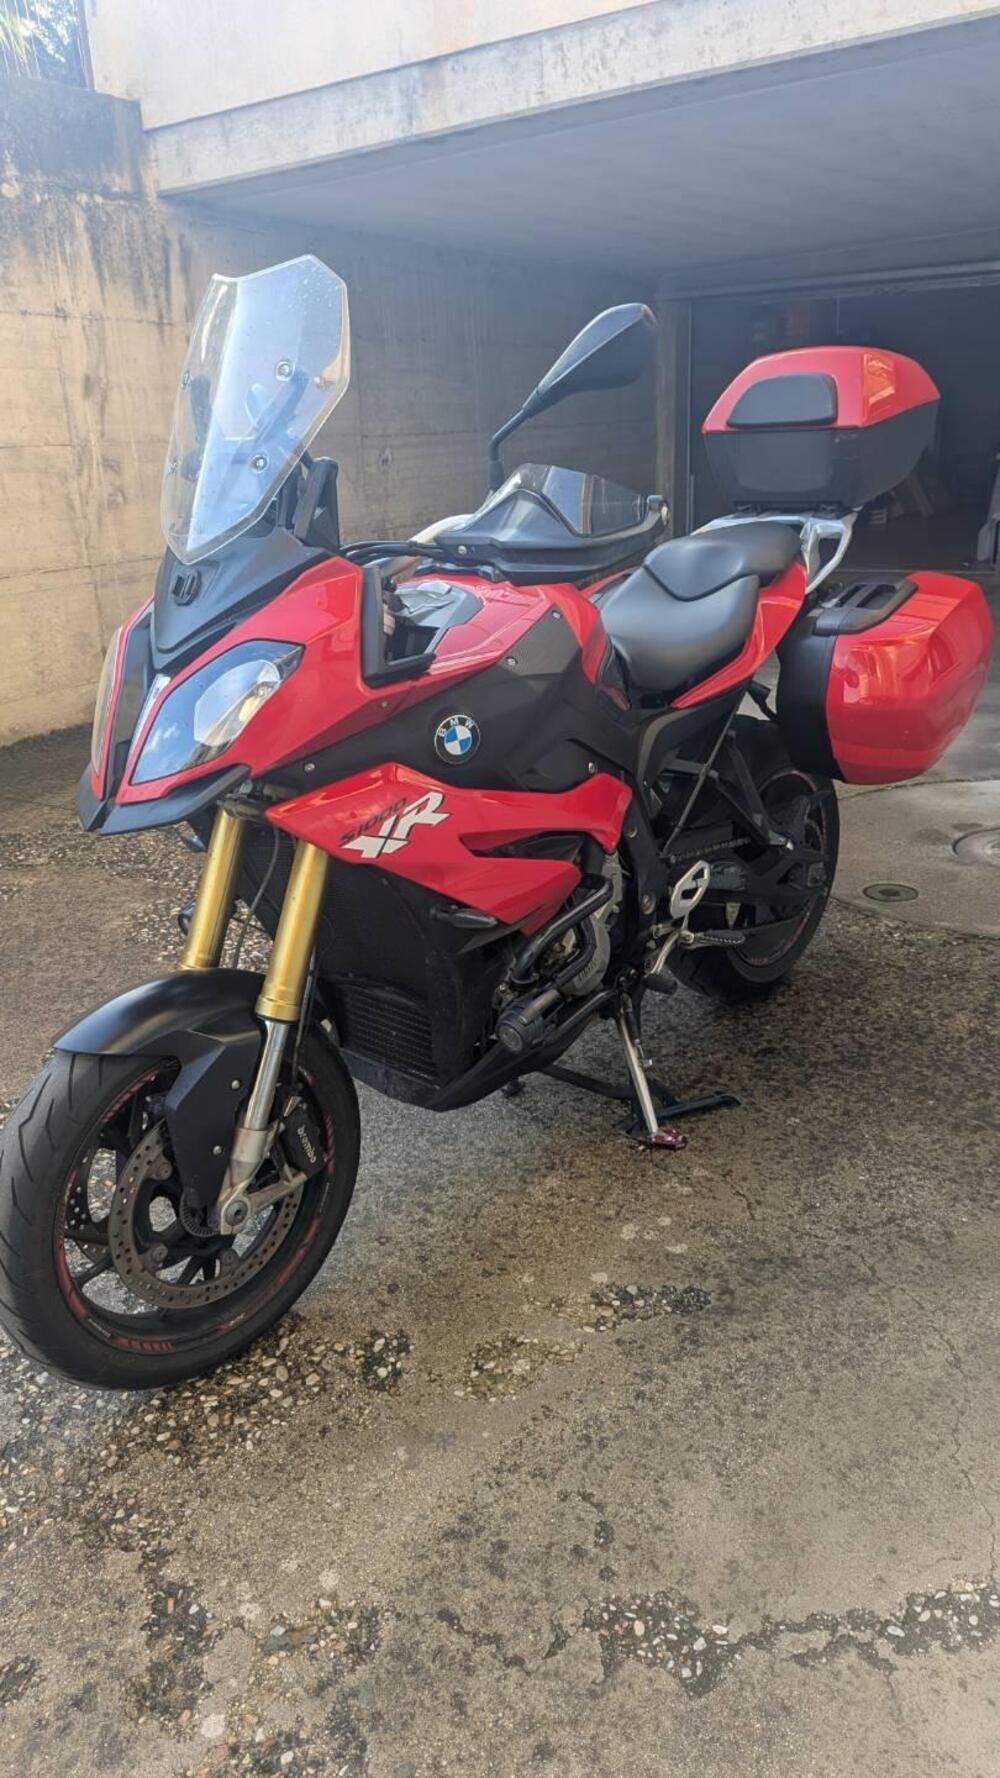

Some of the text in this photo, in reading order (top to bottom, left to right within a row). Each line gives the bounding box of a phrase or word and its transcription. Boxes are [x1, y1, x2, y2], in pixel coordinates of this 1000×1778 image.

[437, 717, 475, 737] BMW
[339, 797, 406, 845] S1000
[340, 791, 451, 859] XR
[297, 1124, 317, 1163] brembo
